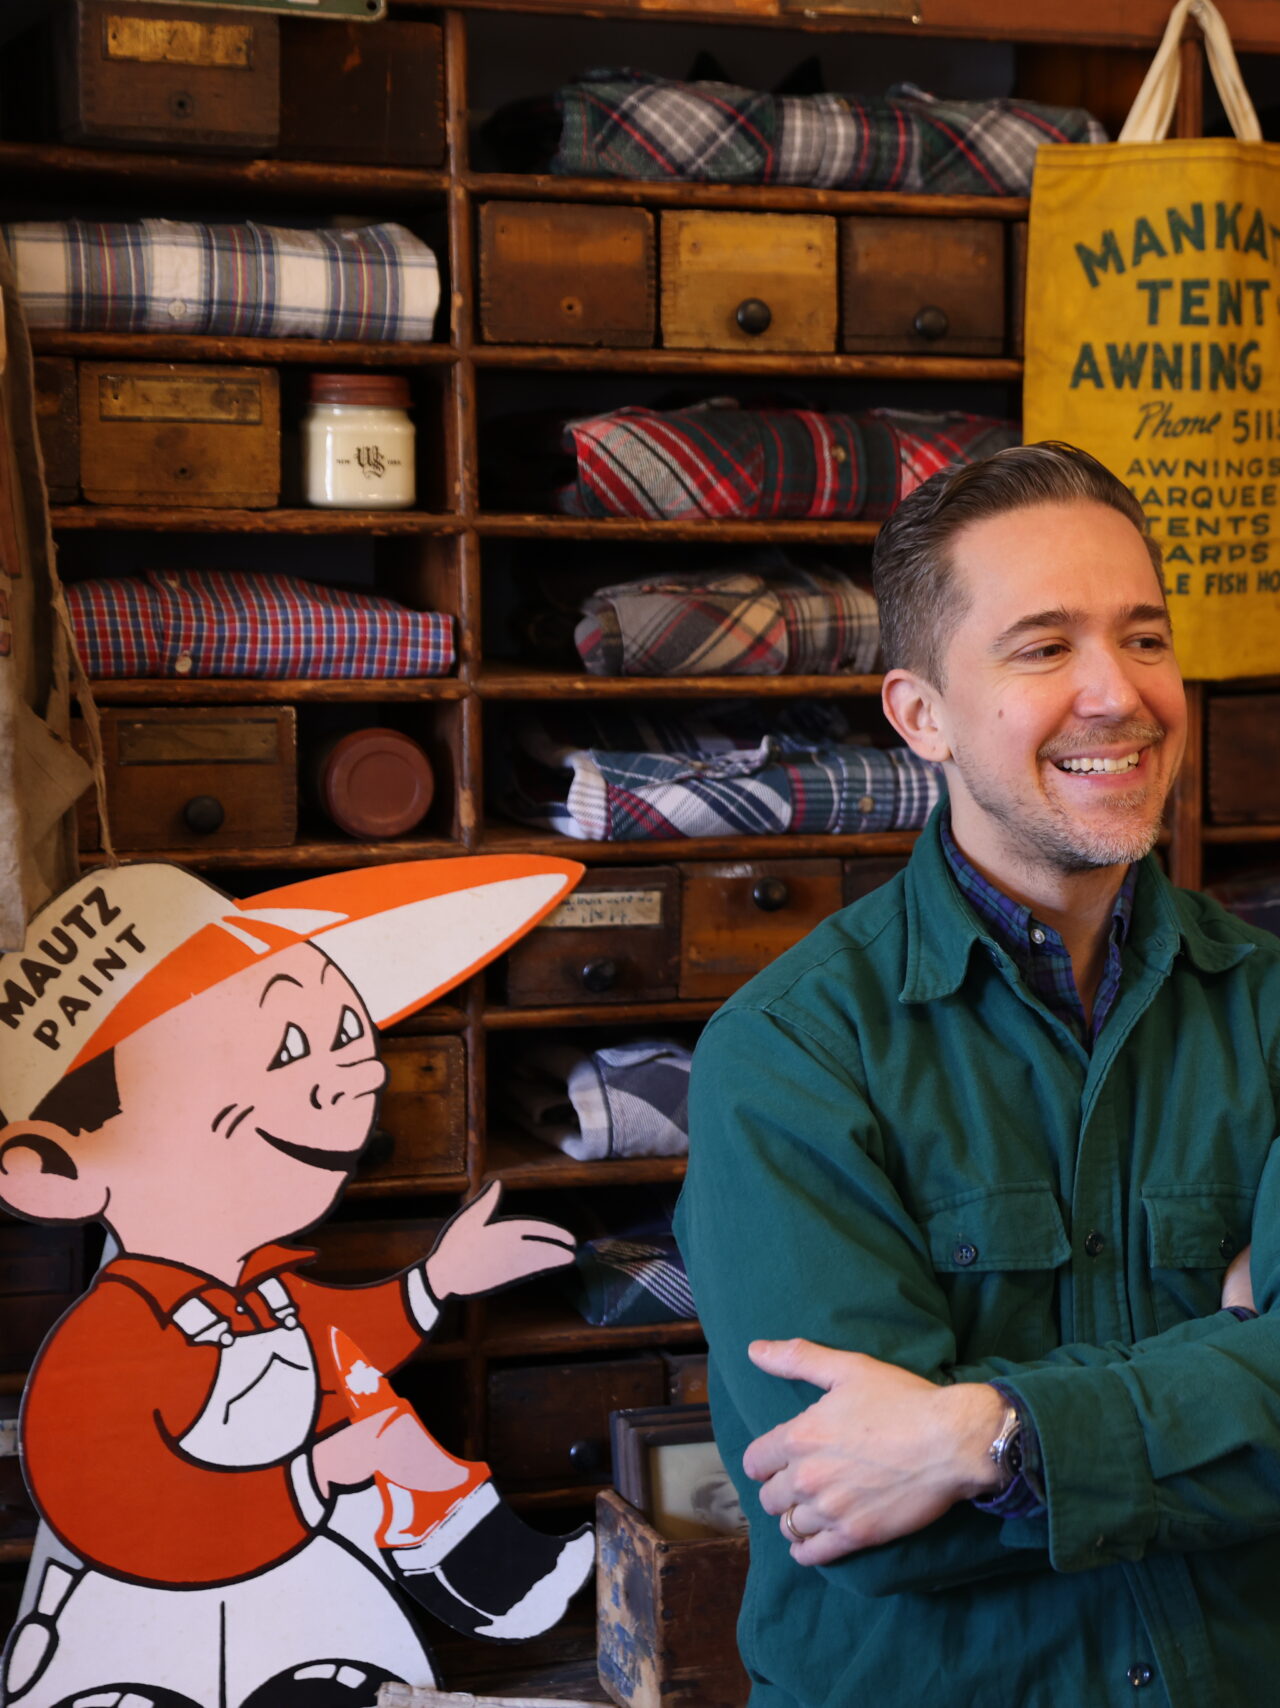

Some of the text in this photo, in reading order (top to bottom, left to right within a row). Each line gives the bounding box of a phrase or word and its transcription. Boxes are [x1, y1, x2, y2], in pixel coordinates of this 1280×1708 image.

[1136, 278, 1271, 327] TENT
[1069, 341, 1262, 392] AWNING
[1133, 401, 1222, 441] Phone
[1145, 513, 1271, 538] TENTS
[1164, 541, 1271, 565] ARPS
[1204, 572, 1249, 597] FISH
[0, 886, 121, 1029] MAUTZ
[33, 923, 146, 1051] PAINT
